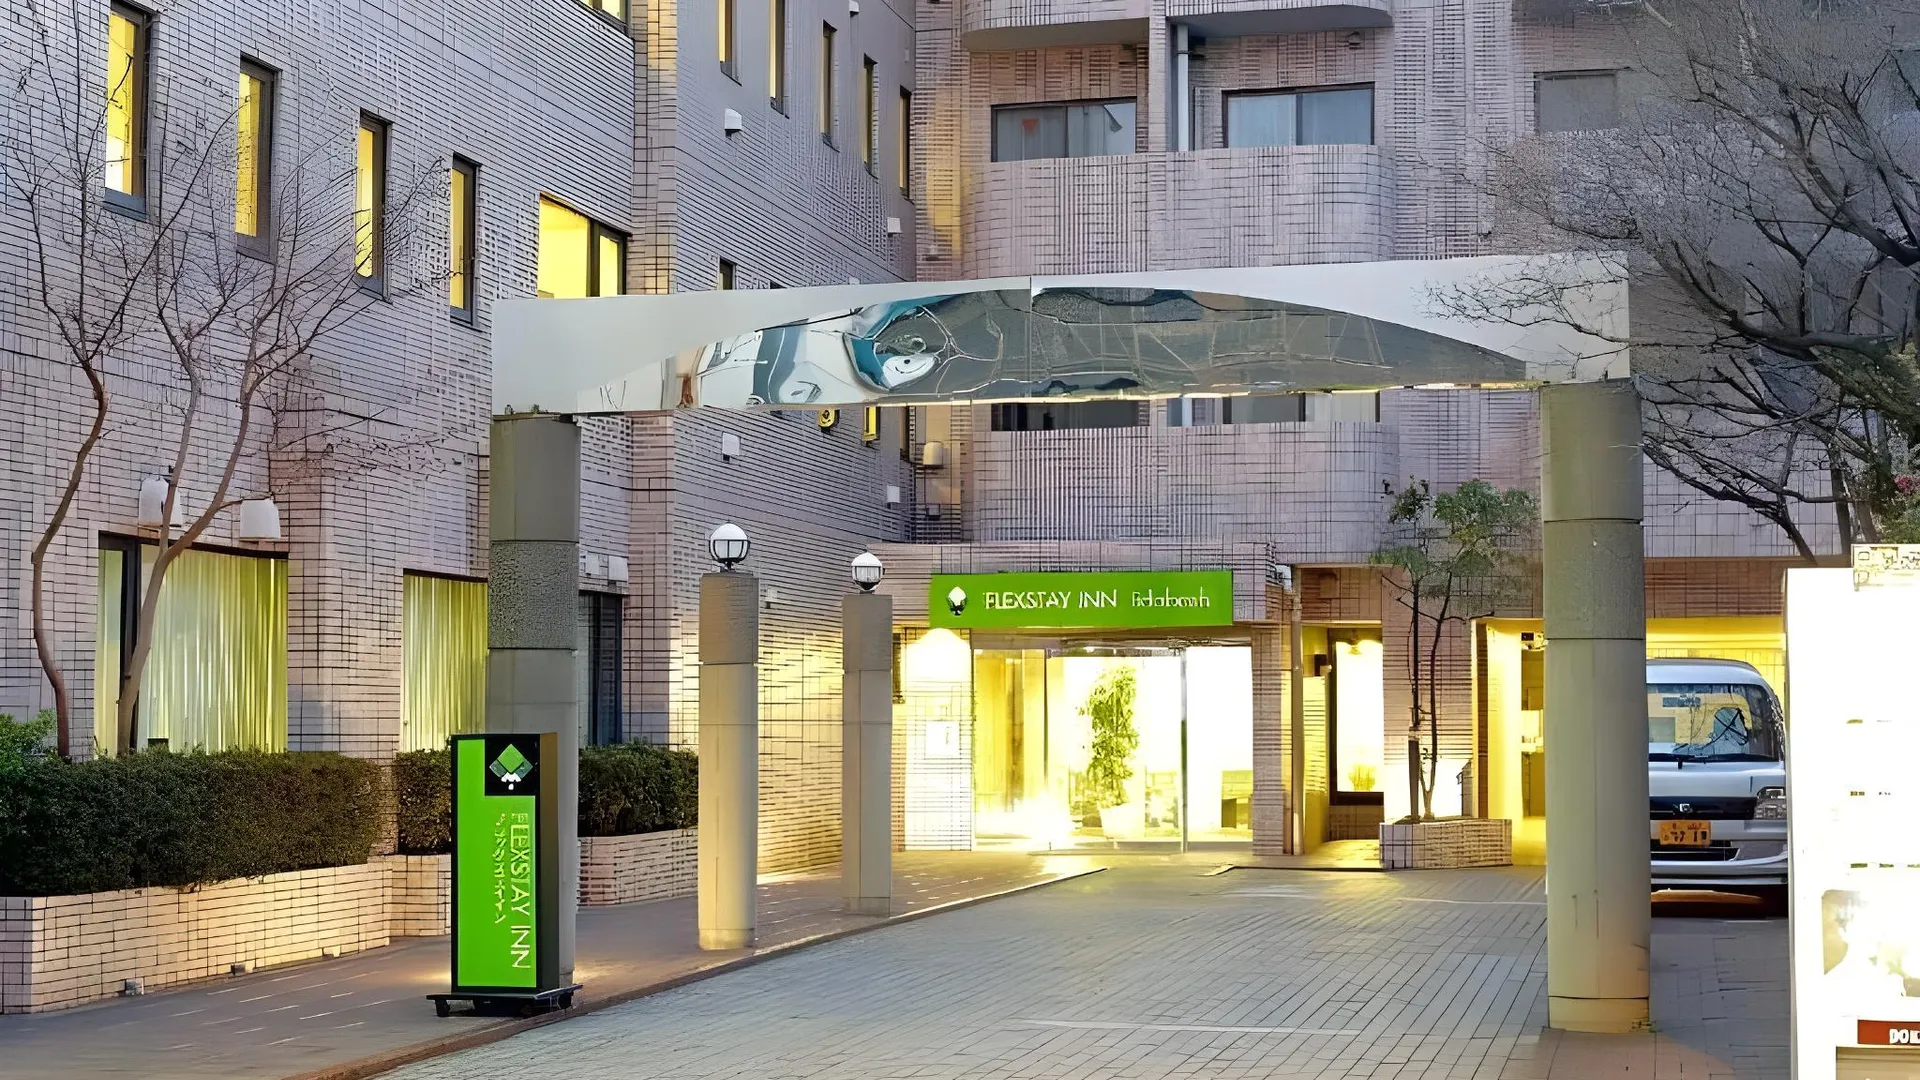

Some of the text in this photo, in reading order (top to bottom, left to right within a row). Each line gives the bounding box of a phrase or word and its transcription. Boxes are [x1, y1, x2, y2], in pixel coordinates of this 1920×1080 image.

[985, 591, 1071, 609] FLEXSTAY
[1079, 589, 1117, 609] INN
[510, 925, 531, 968] INN
